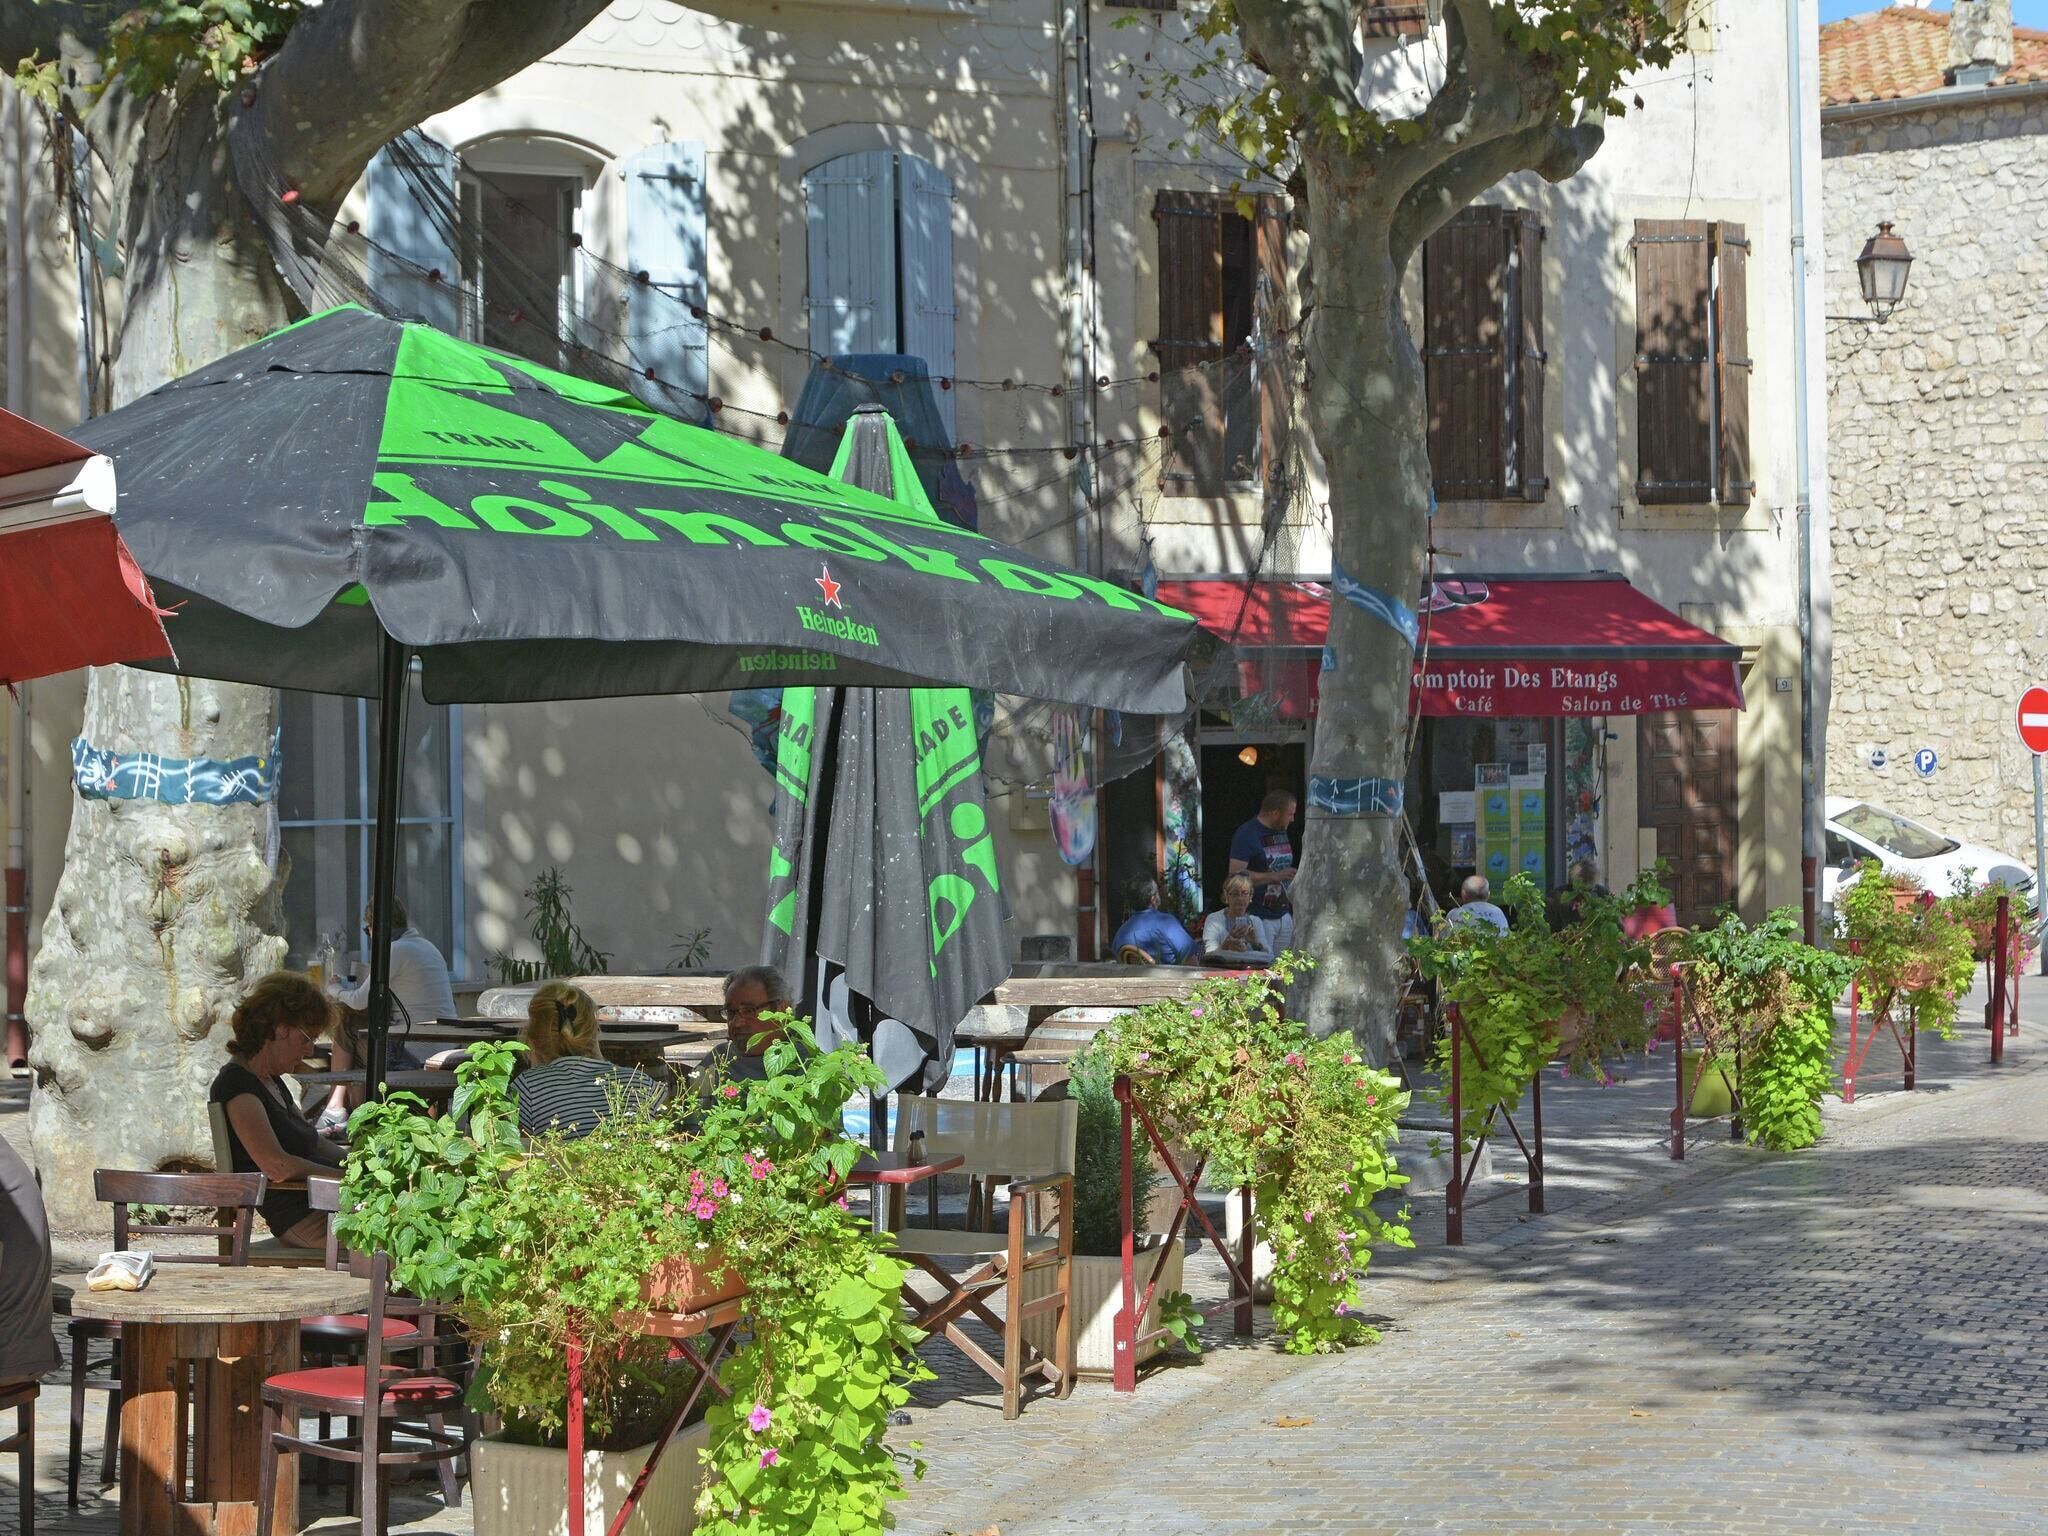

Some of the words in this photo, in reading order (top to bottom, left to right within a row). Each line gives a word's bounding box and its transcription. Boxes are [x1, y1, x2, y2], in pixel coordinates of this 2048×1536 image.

[424, 430, 545, 454] TRADE
[796, 606, 880, 646] Heineken
[1413, 668, 1496, 692] omptoir
[1504, 667, 1541, 689] Des
[1551, 668, 1618, 693] Etangs
[1455, 695, 1493, 712] Café
[1562, 696, 1612, 712] Salon
[1620, 696, 1642, 711] de
[1650, 691, 1688, 709] Thé
[1920, 751, 1934, 771] P
